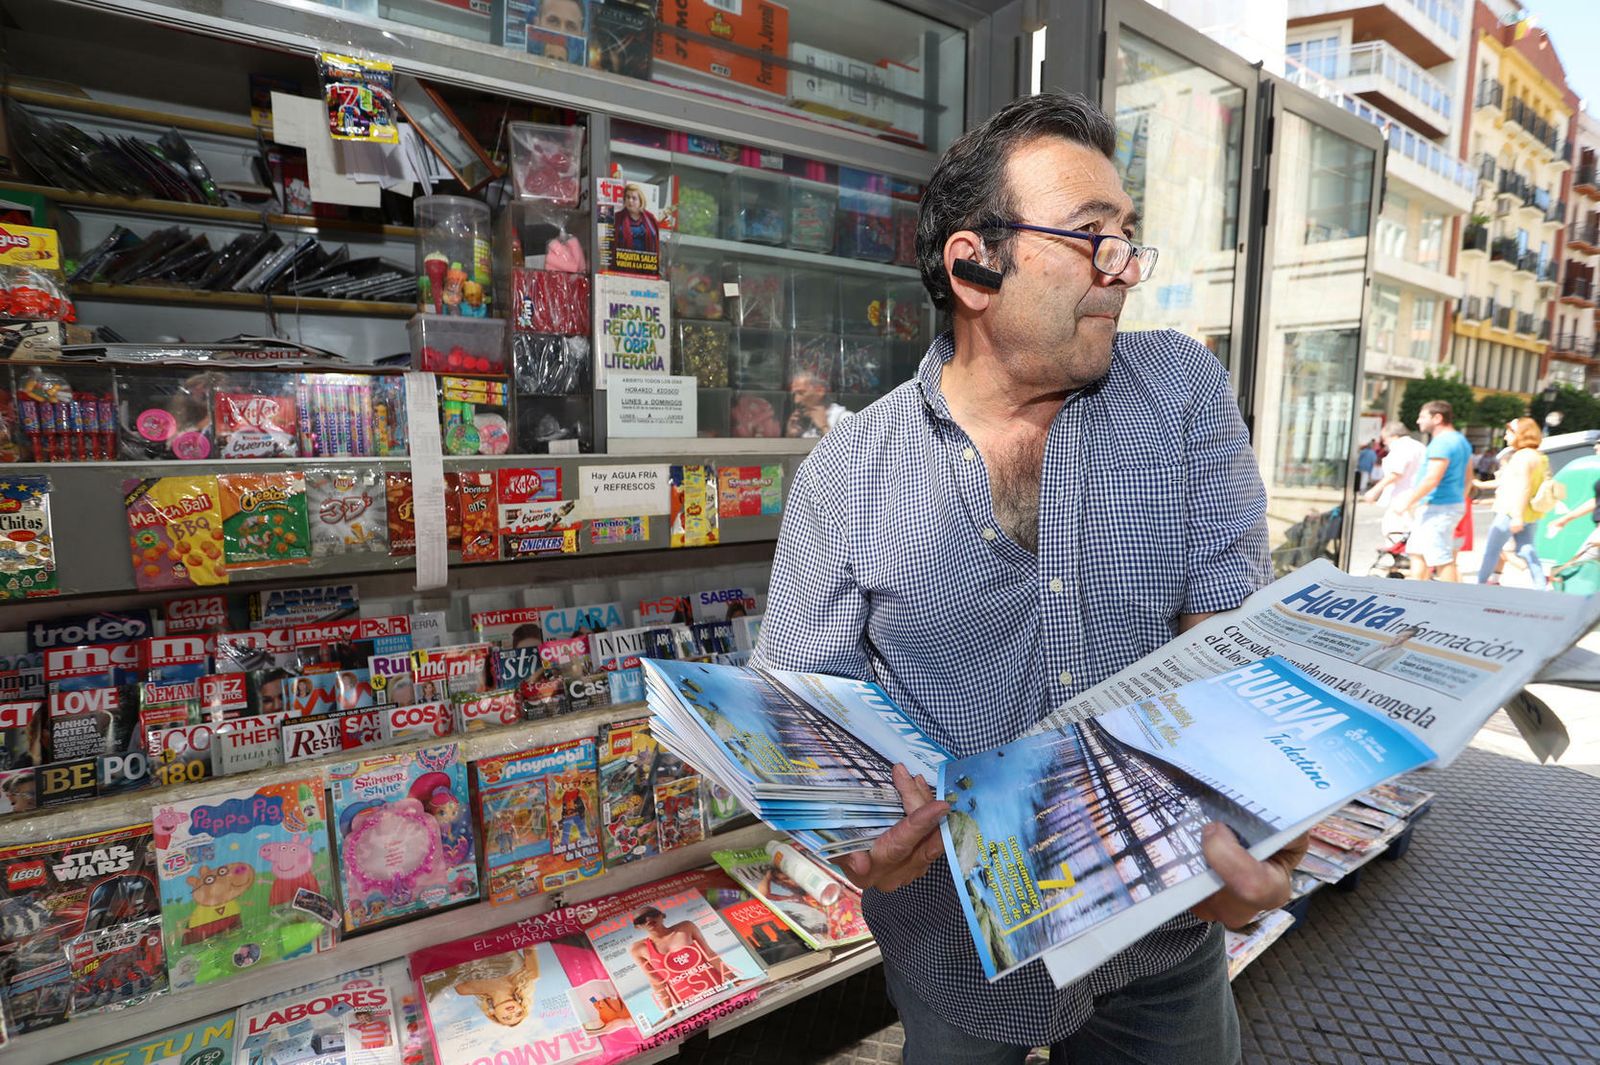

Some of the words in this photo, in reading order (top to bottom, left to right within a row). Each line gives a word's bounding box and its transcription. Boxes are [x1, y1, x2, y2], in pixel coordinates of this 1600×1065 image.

[609, 303, 642, 321] MESA
[646, 305, 661, 323] DE
[603, 319, 666, 340] RELOJERO
[613, 337, 622, 351] Y
[623, 337, 657, 354] OBRA
[604, 352, 665, 372] LITERARIA
[591, 472, 607, 481] Hay
[612, 471, 636, 480] AGUA
[638, 471, 658, 479] FRIA
[463, 486, 490, 494] Doritos
[603, 482, 656, 492] REFRESCOS
[180, 496, 210, 516] Ball
[467, 499, 487, 513] BITS
[521, 510, 552, 524] bueno
[594, 519, 629, 529] mentos
[169, 516, 211, 540] BBQ
[518, 536, 564, 551] SNICKERS
[169, 597, 224, 617] caza
[700, 589, 744, 605] SABER
[1281, 583, 1406, 630] Huelva
[169, 615, 225, 630] mayor
[361, 617, 408, 638] P&R
[544, 605, 622, 635] CLARA
[33, 617, 146, 647] trofeo
[1204, 634, 1224, 646] el
[1214, 643, 1232, 656] de
[1226, 650, 1243, 663] los
[1224, 625, 1252, 648] Cruz
[1334, 678, 1366, 698] 14%
[1368, 692, 1436, 730] congela
[203, 679, 242, 697] DIEZ
[51, 687, 119, 718] LOVE
[1206, 662, 1350, 742] HUELVA
[53, 718, 98, 731] AINHOA
[53, 726, 97, 738] ARTETA
[228, 728, 280, 748] THER
[613, 737, 631, 748] LEGO
[104, 752, 150, 785] PO
[157, 759, 205, 785] 180
[505, 747, 585, 778] playmobil
[1279, 736, 1331, 790] destino
[42, 763, 96, 795] BE
[193, 808, 250, 833] Peppa
[253, 799, 282, 821] Pig
[62, 845, 134, 867] STAR
[976, 833, 989, 863] Huelva
[52, 855, 134, 882] WARS
[165, 855, 186, 871] 75
[1007, 835, 1041, 910] Establecimientos
[12, 867, 42, 882] LEGO
[986, 870, 995, 881] su
[998, 841, 1011, 861] para
[1006, 862, 1026, 902] disfrutar
[1021, 902, 1032, 915] de
[622, 887, 657, 904] VERANO
[992, 853, 1016, 907] exquisiteces
[1011, 907, 1021, 920] de
[988, 881, 1012, 925] provincia
[517, 910, 562, 928] MAXI
[473, 939, 492, 951] EL
[512, 932, 552, 947] PARA
[249, 989, 388, 1035] LABORES
[140, 1032, 194, 1065] TU
[202, 1018, 236, 1047] M
